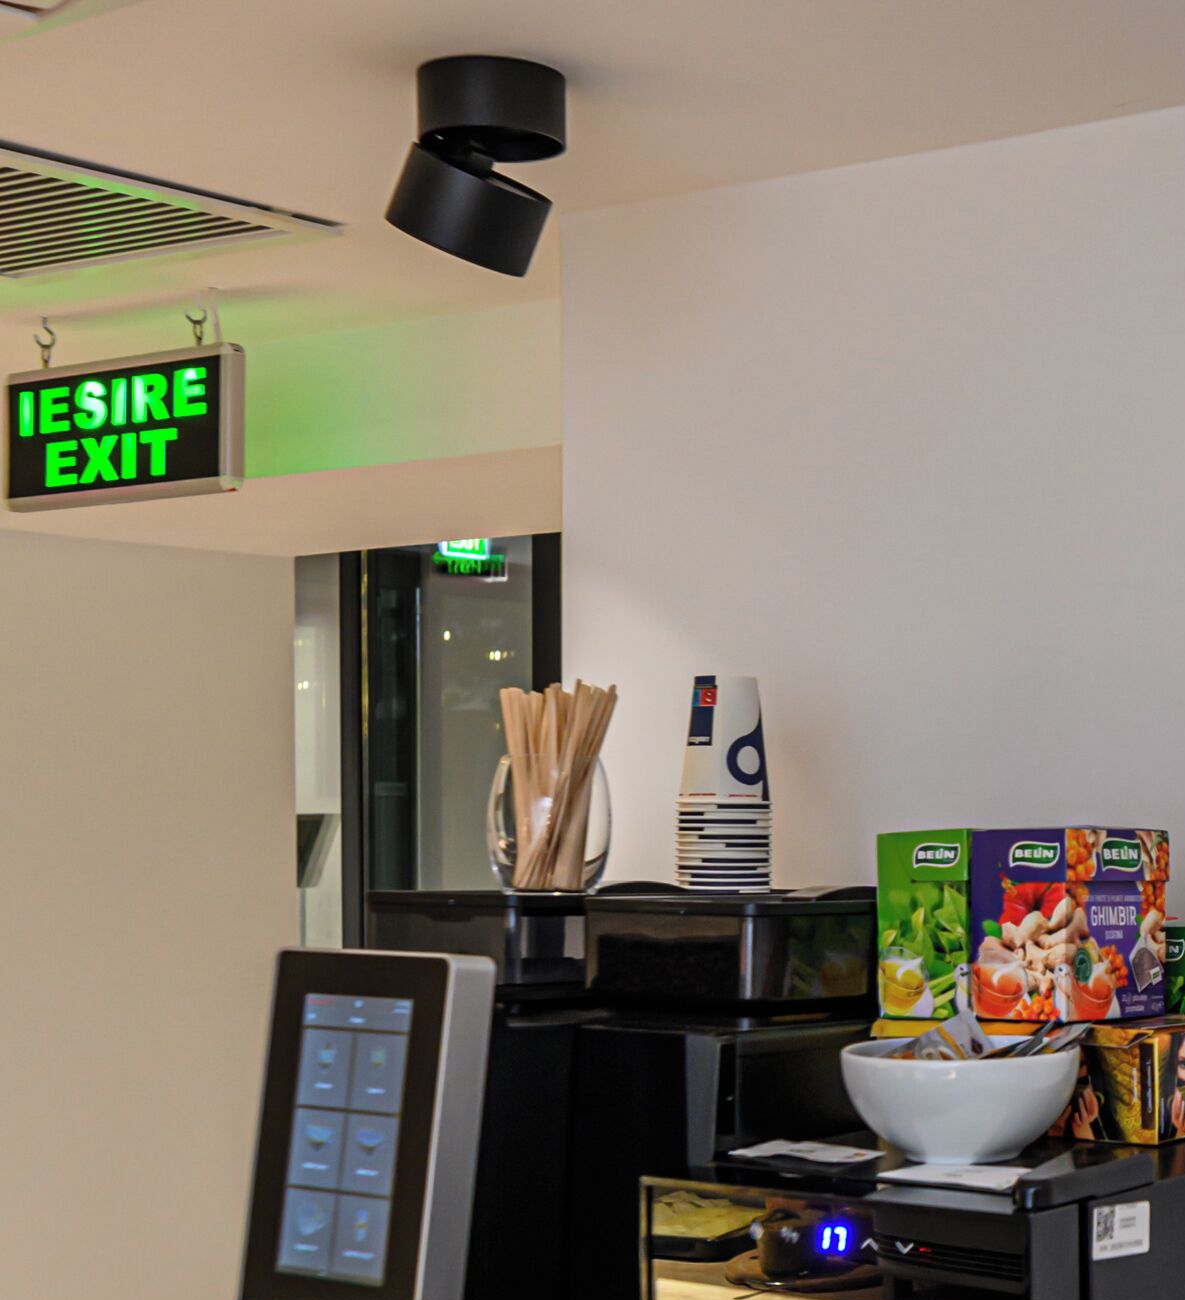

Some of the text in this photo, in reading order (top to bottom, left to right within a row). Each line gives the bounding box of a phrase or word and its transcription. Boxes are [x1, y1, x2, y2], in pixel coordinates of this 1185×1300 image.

[19, 367, 207, 437] IESIRE
[45, 428, 178, 488] EXIT
[917, 848, 955, 859] BELIN
[1014, 847, 1054, 858] BELIN
[1103, 845, 1138, 860] BELIN
[1090, 905, 1137, 927] GHIMBIR
[822, 1226, 847, 1251] 17
